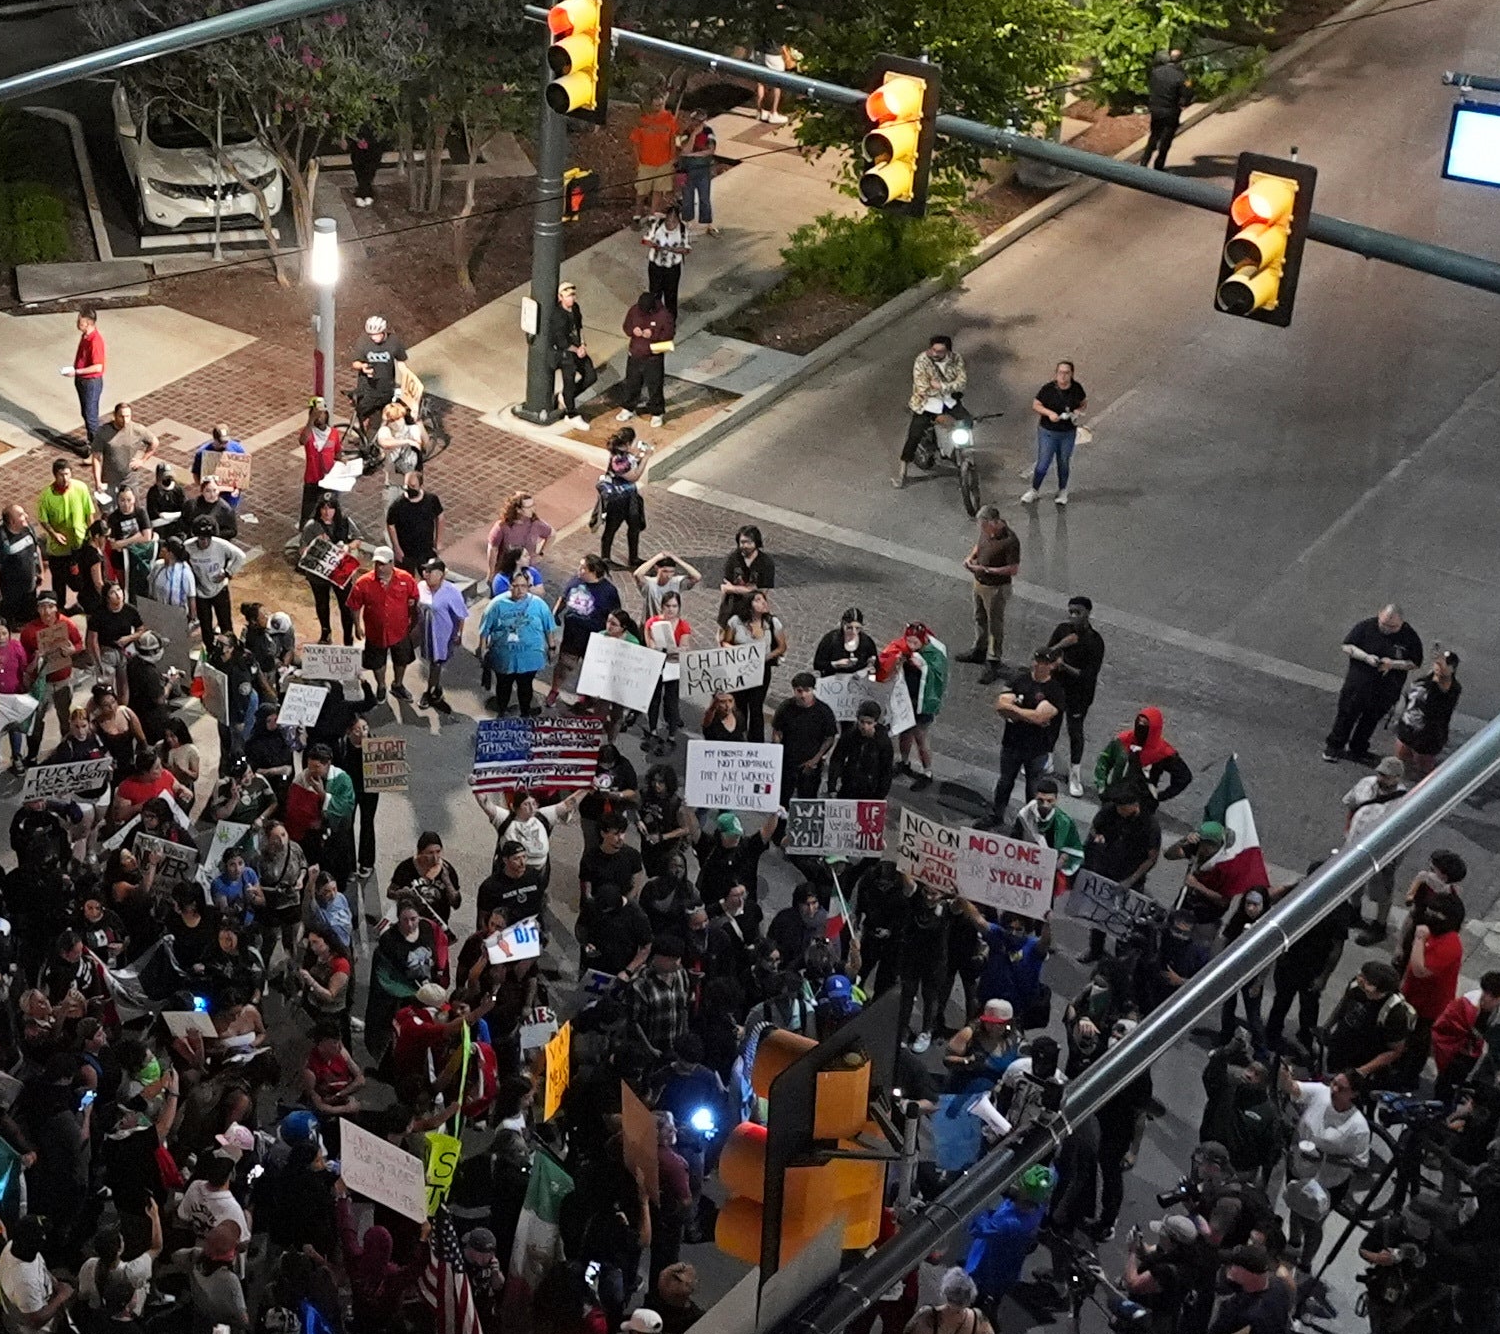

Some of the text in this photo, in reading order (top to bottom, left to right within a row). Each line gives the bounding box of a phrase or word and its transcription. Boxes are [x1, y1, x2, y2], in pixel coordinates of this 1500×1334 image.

[322, 655, 352, 664] STOLEN
[686, 645, 760, 670] CHINGA
[688, 669, 713, 682] LA
[688, 674, 746, 695] MIGRA
[820, 681, 844, 696] NO
[36, 762, 106, 779] FUCK ICE
[717, 759, 735, 768] NOT
[700, 770, 776, 783] THEY ARE WORKERS
[720, 784, 744, 795] WITH
[866, 806, 880, 820] IF
[807, 820, 823, 831] IT
[906, 814, 960, 848] NO ON
[903, 833, 916, 847] IS
[969, 835, 1042, 865] NO ONE
[989, 867, 1043, 891] STOLEN
[514, 927, 539, 945] DJT
[434, 1152, 456, 1178] S
